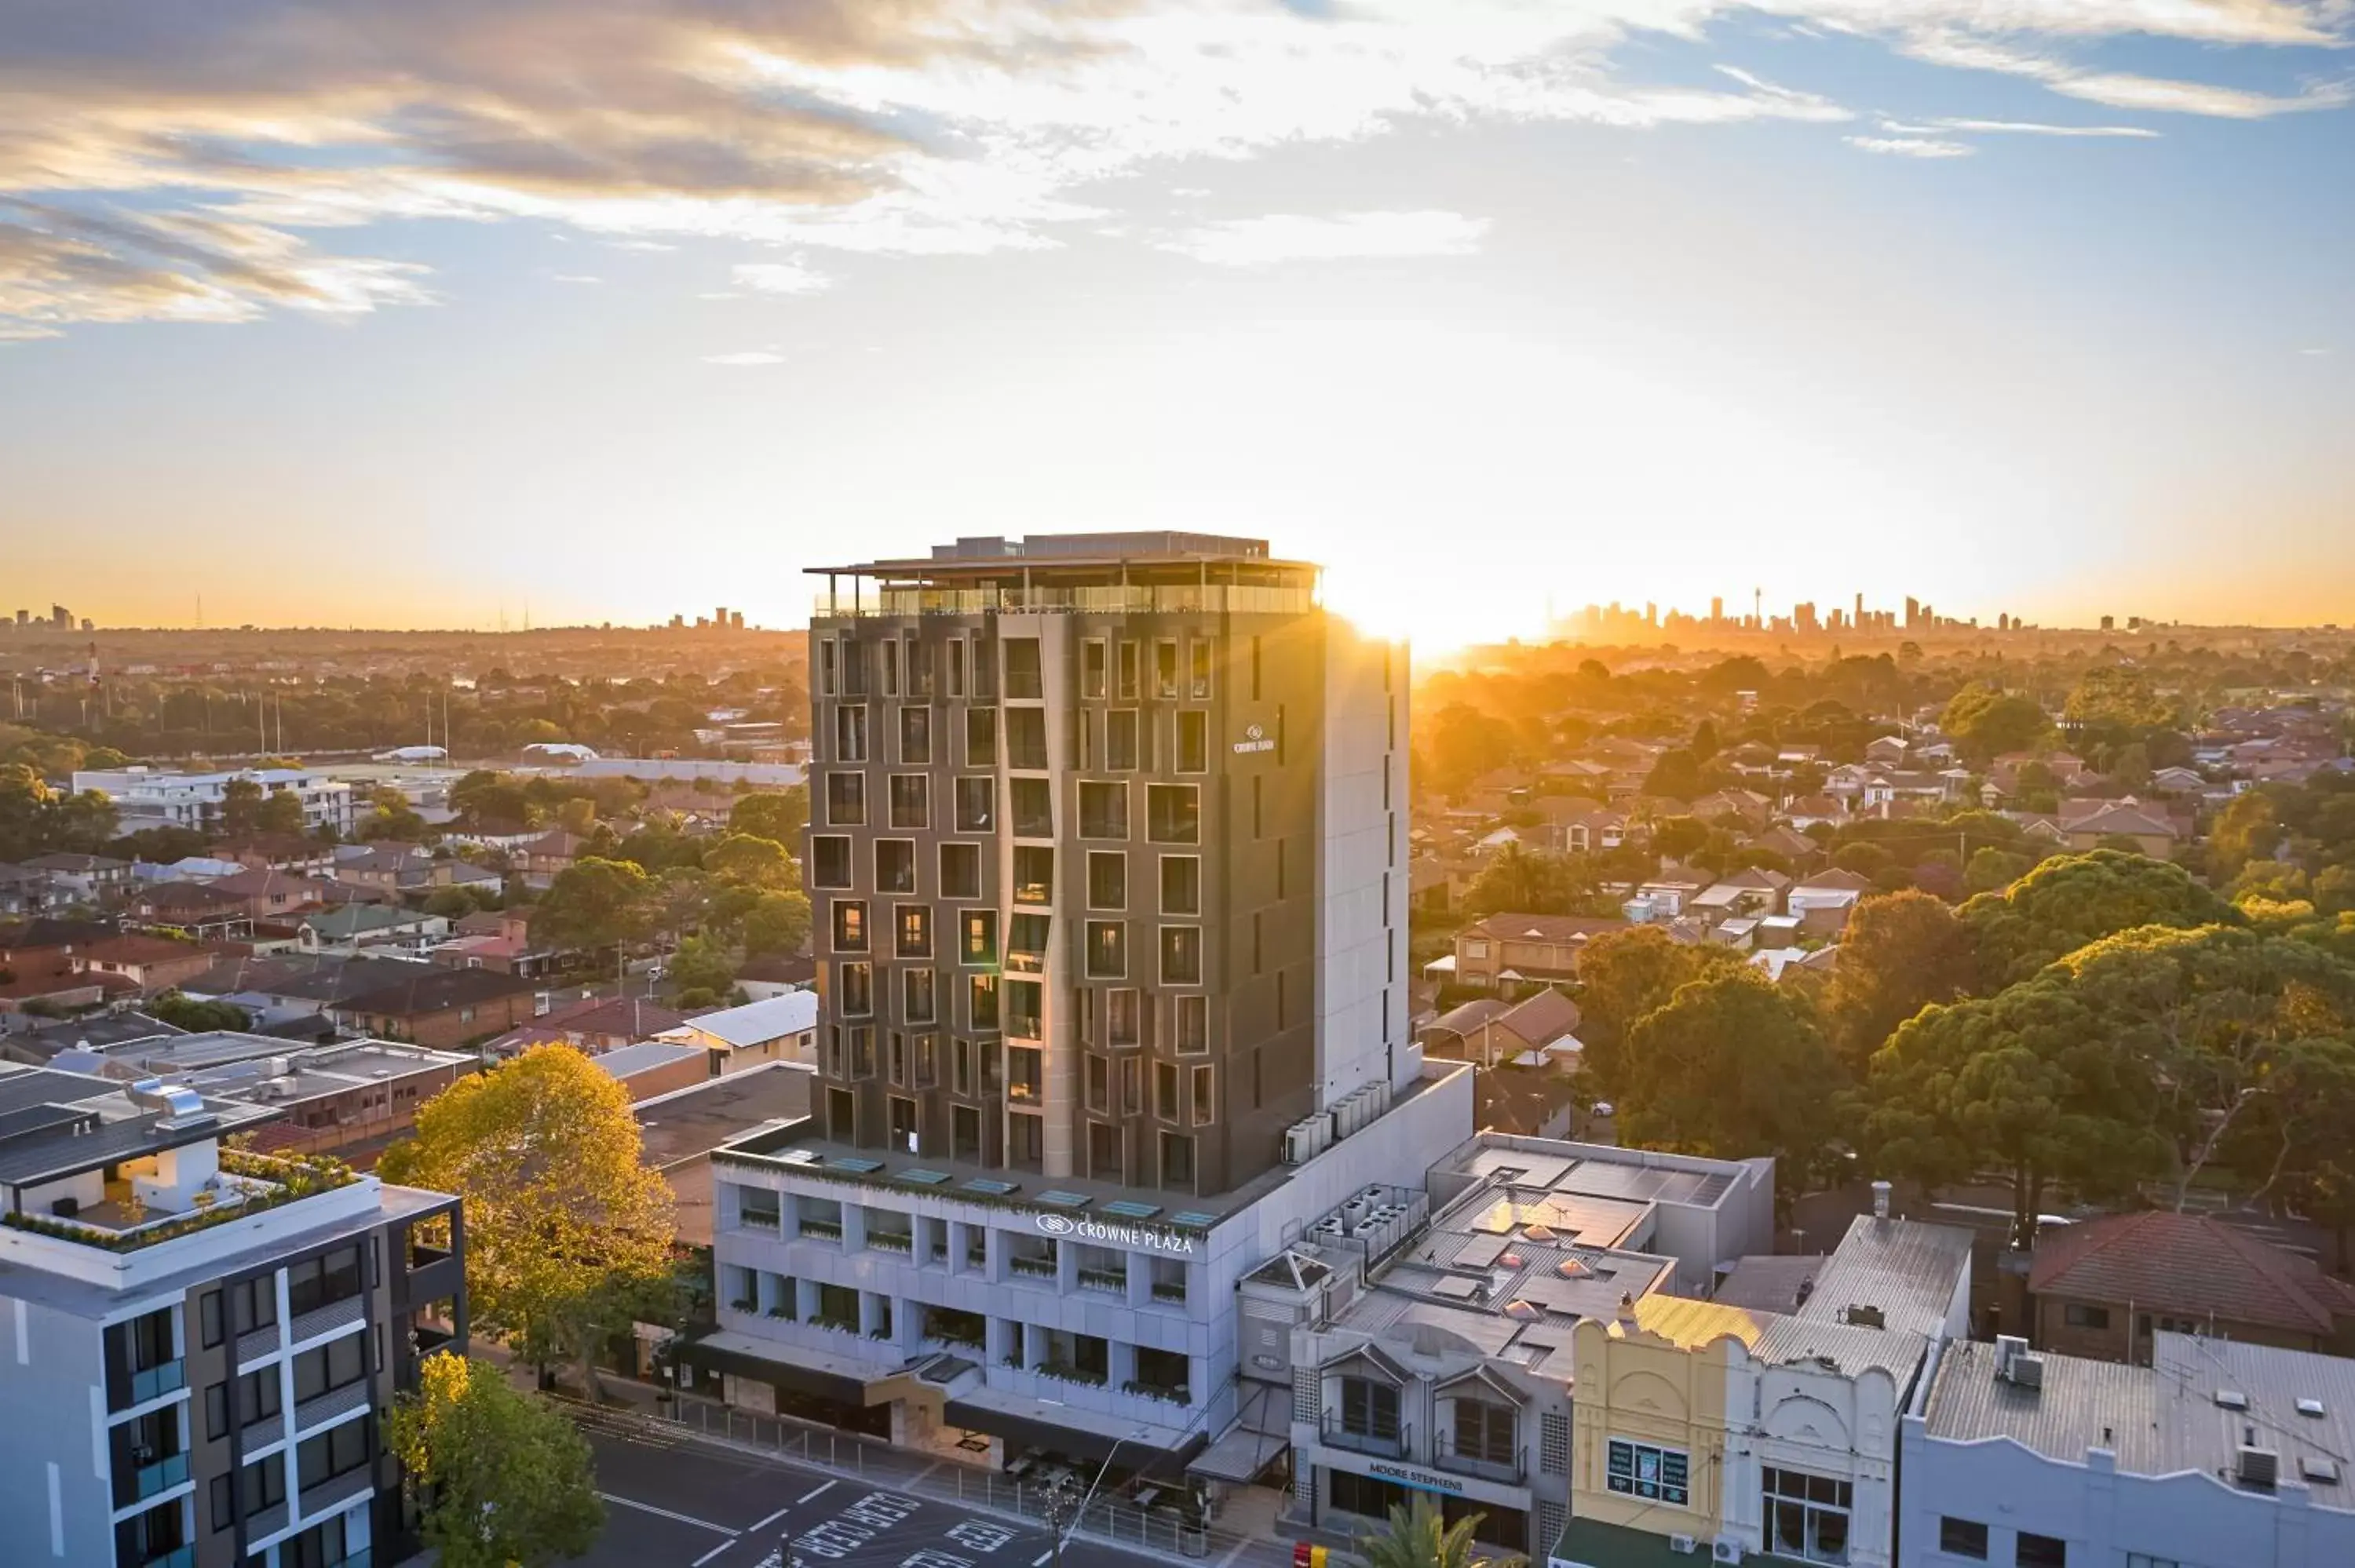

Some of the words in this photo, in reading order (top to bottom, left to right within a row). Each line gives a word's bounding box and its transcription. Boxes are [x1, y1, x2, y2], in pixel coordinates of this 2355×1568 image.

[1077, 1221, 1139, 1245] CROWNE
[1145, 1233, 1192, 1254] PLAZA
[1369, 1462, 1408, 1479] MOORE
[838, 1491, 922, 1528] CLEAR
[789, 1520, 876, 1558] CLEAR
[944, 1518, 1020, 1552] KEEP
